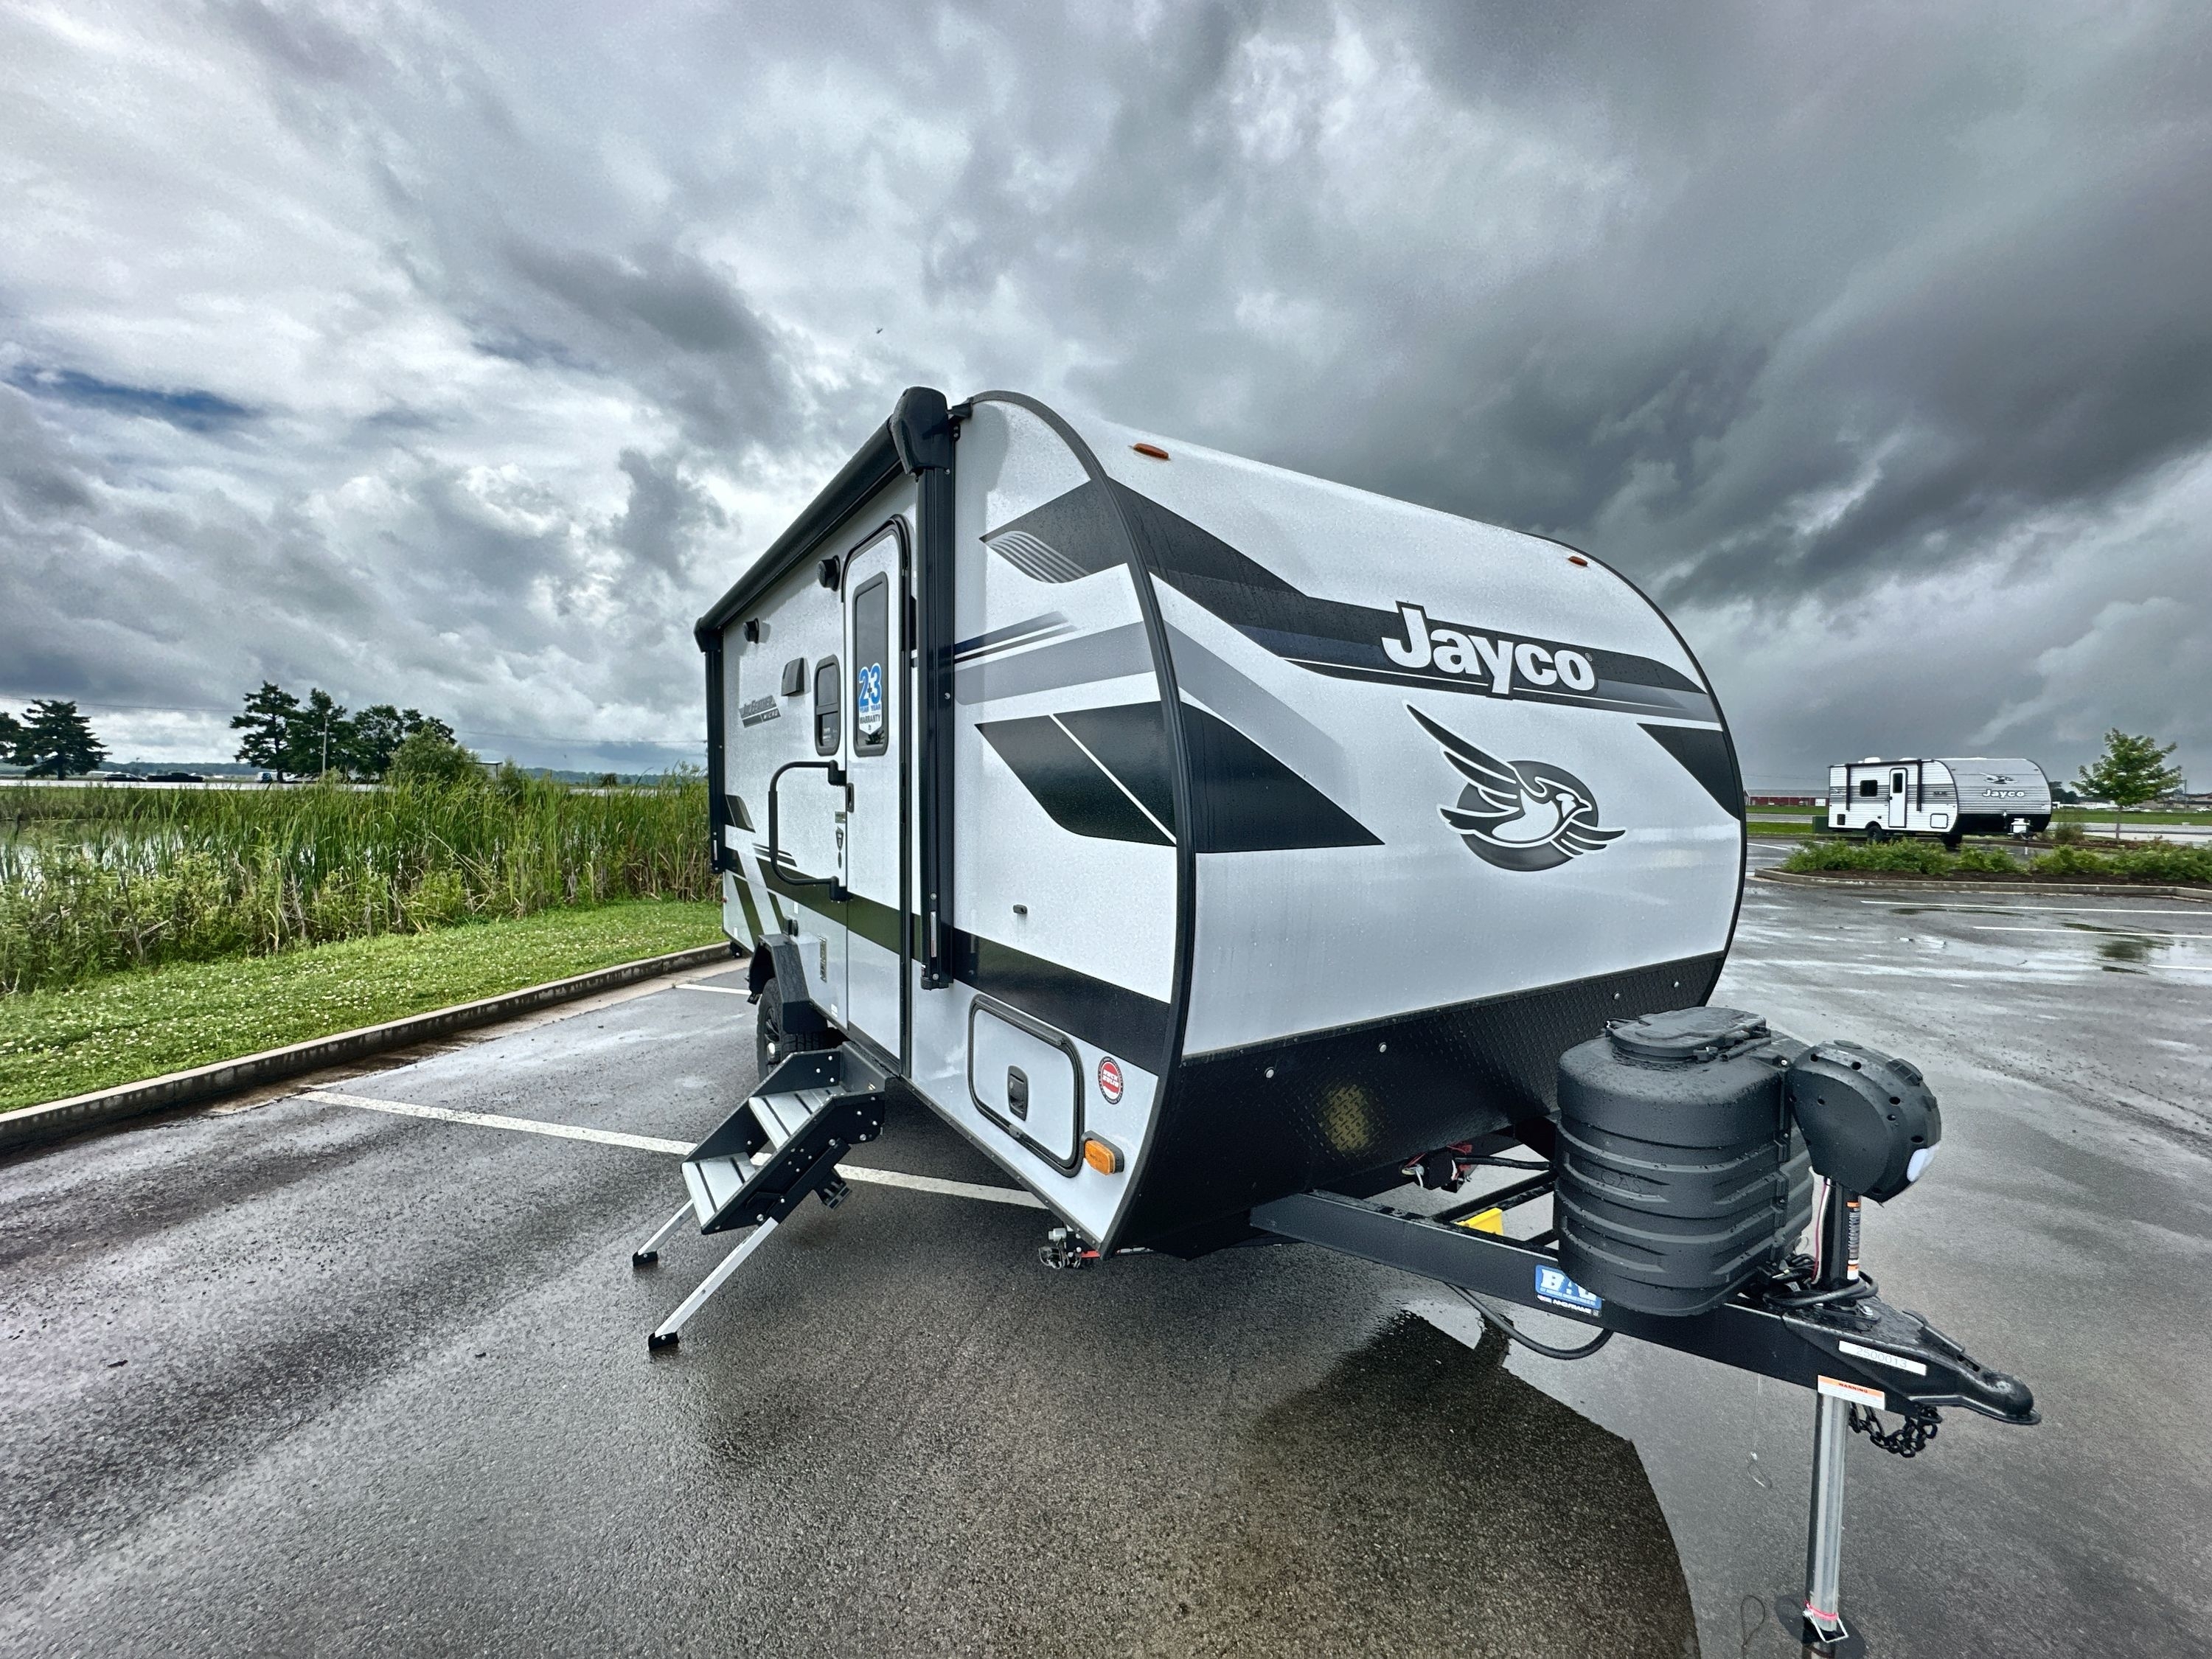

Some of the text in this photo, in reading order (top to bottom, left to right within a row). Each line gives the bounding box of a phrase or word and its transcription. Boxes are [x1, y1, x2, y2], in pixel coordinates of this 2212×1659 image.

[1380, 605, 1596, 695] Jayco
[860, 713, 881, 724] WARRANTY
[1982, 788, 2025, 799] Jayco
[1856, 1346, 1907, 1368] 2500013
[1838, 1382, 1868, 1394] WARNING
